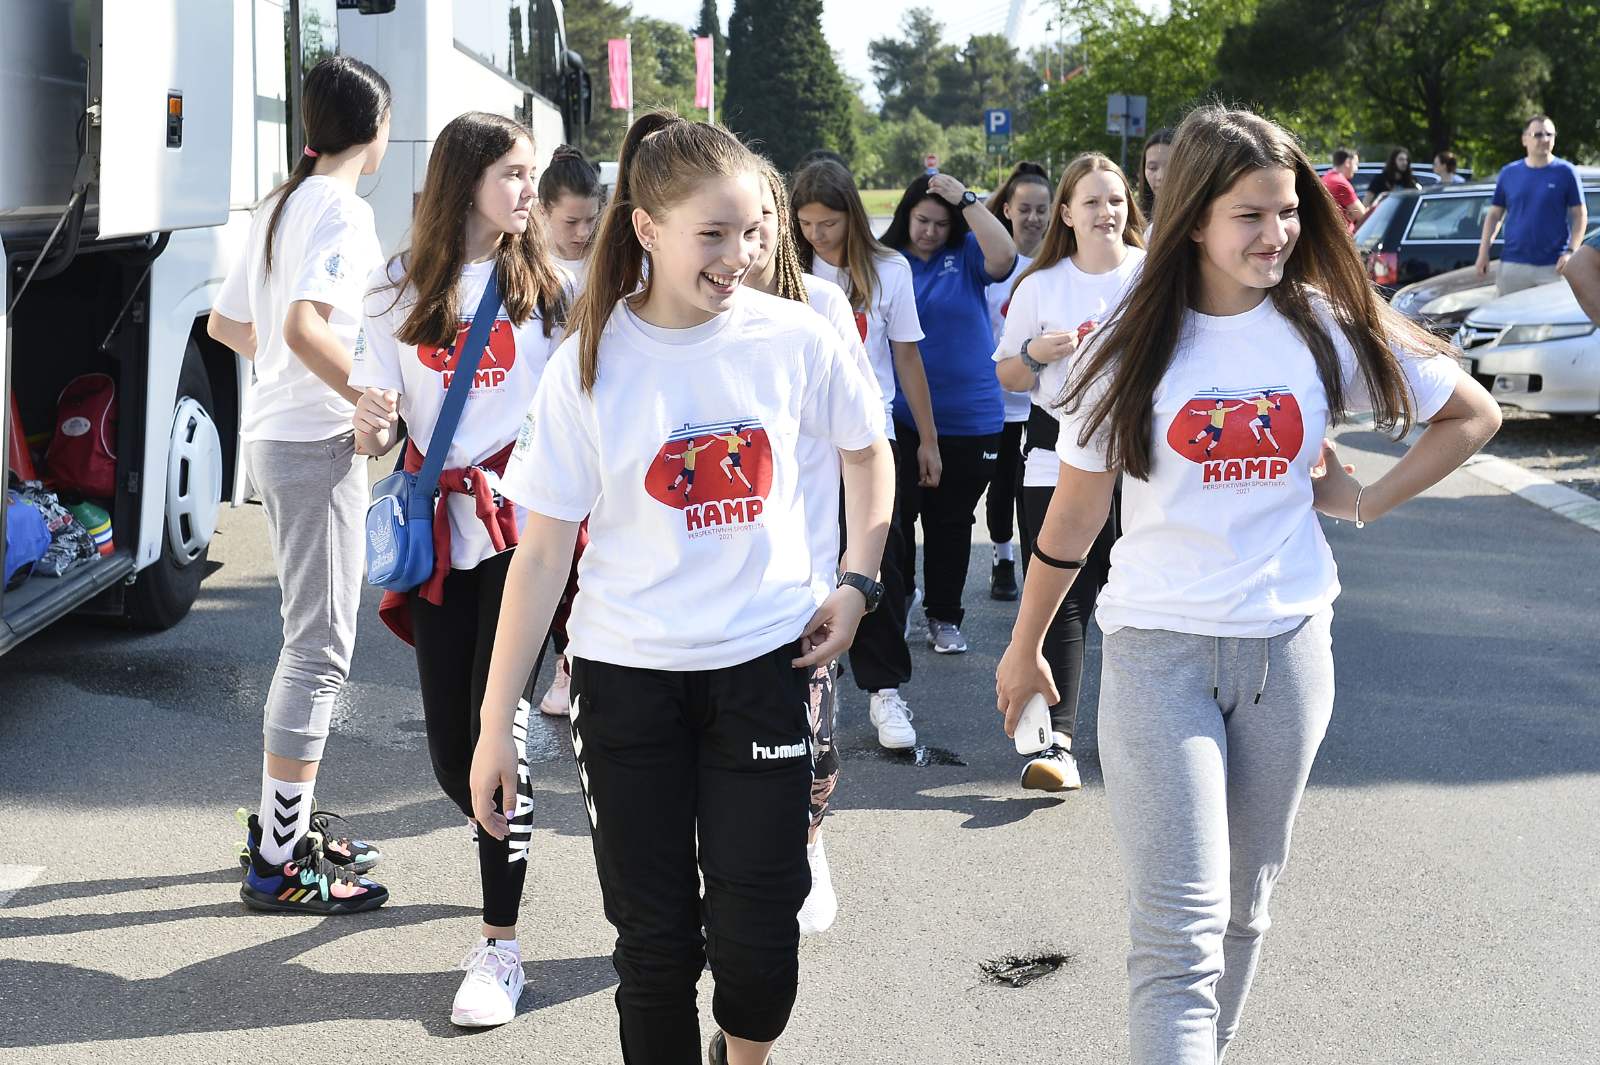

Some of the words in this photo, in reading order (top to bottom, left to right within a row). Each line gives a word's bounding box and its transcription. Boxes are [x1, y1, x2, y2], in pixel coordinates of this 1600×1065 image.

[991, 112, 1006, 132] P
[443, 370, 505, 389] KMP
[1203, 460, 1288, 483] KAMP
[685, 499, 763, 531] KAMP
[752, 738, 806, 760] hummel
